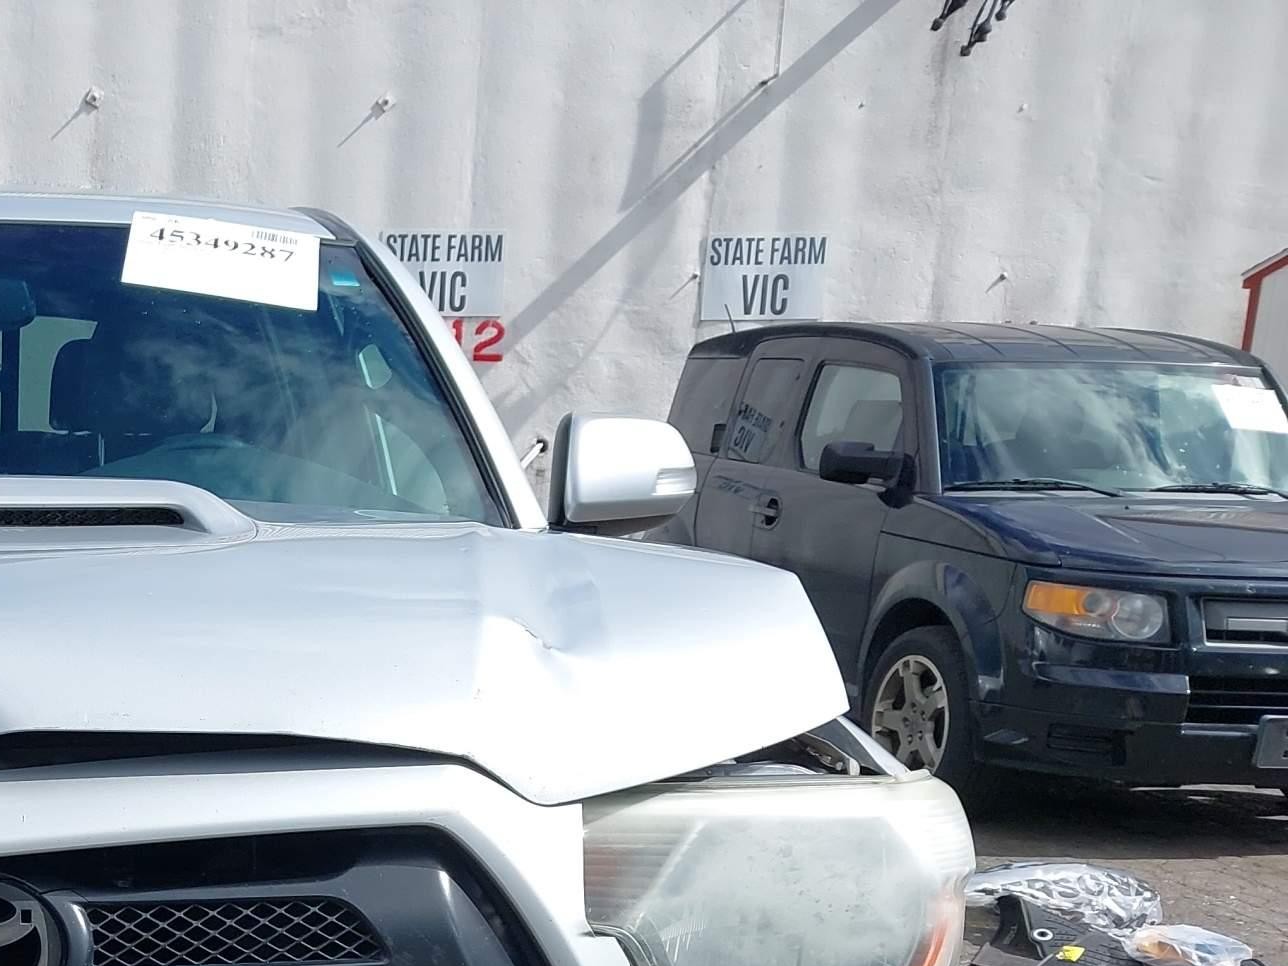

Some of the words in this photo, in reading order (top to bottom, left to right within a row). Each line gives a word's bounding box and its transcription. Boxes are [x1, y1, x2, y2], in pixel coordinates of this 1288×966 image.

[149, 226, 297, 262] 45349287
[386, 233, 441, 262] STATE
[446, 233, 504, 262] FARM
[710, 237, 765, 266] STATE
[769, 236, 828, 265] FARM
[418, 270, 467, 312] VIC
[742, 273, 790, 316] VIC
